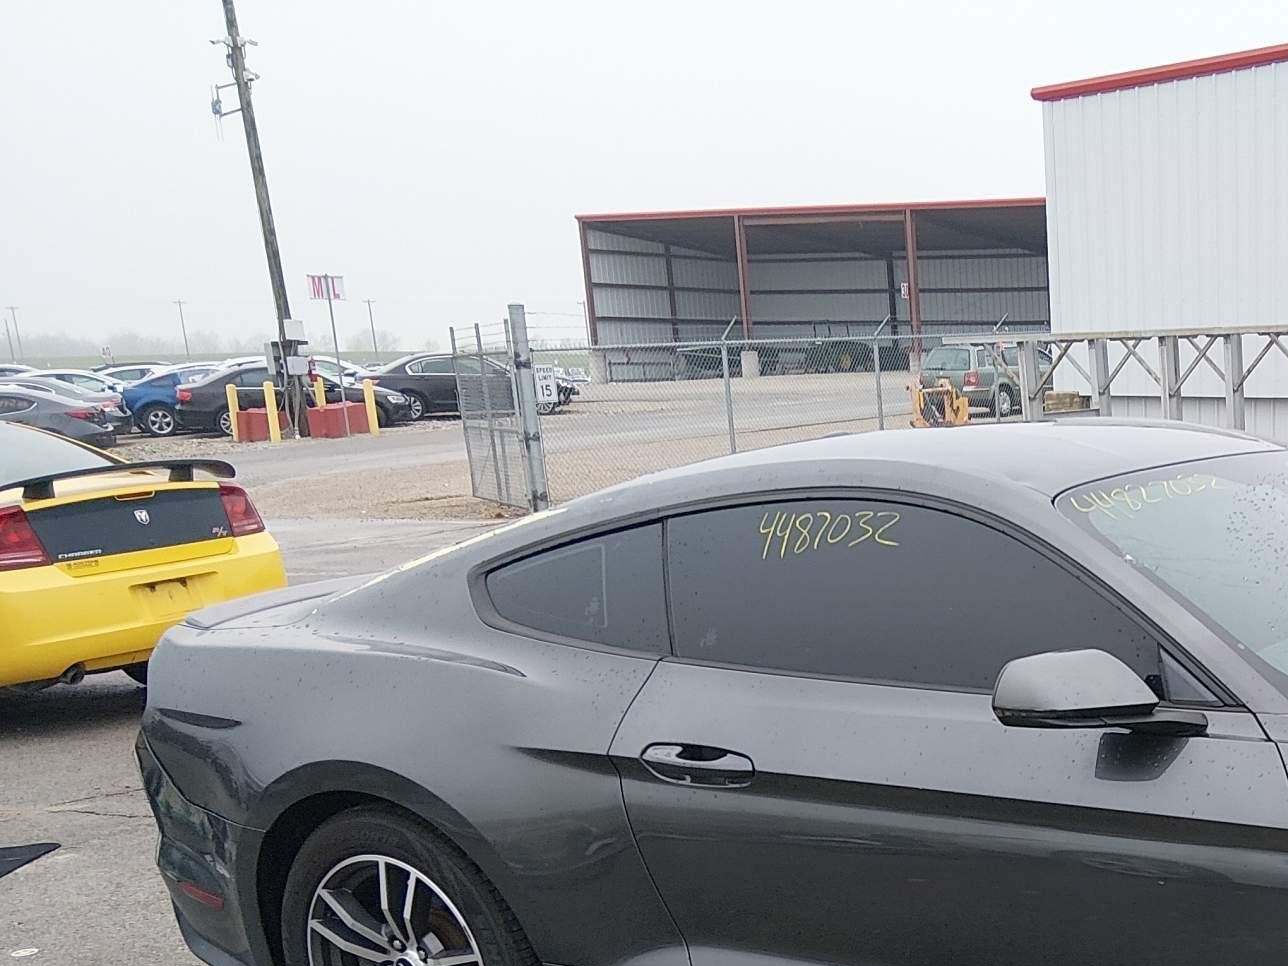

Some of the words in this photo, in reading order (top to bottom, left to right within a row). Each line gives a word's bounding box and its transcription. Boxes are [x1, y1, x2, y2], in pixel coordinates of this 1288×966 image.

[537, 374, 552, 382] LIMIT
[540, 384, 553, 398] 15
[759, 510, 901, 560] 4487032
